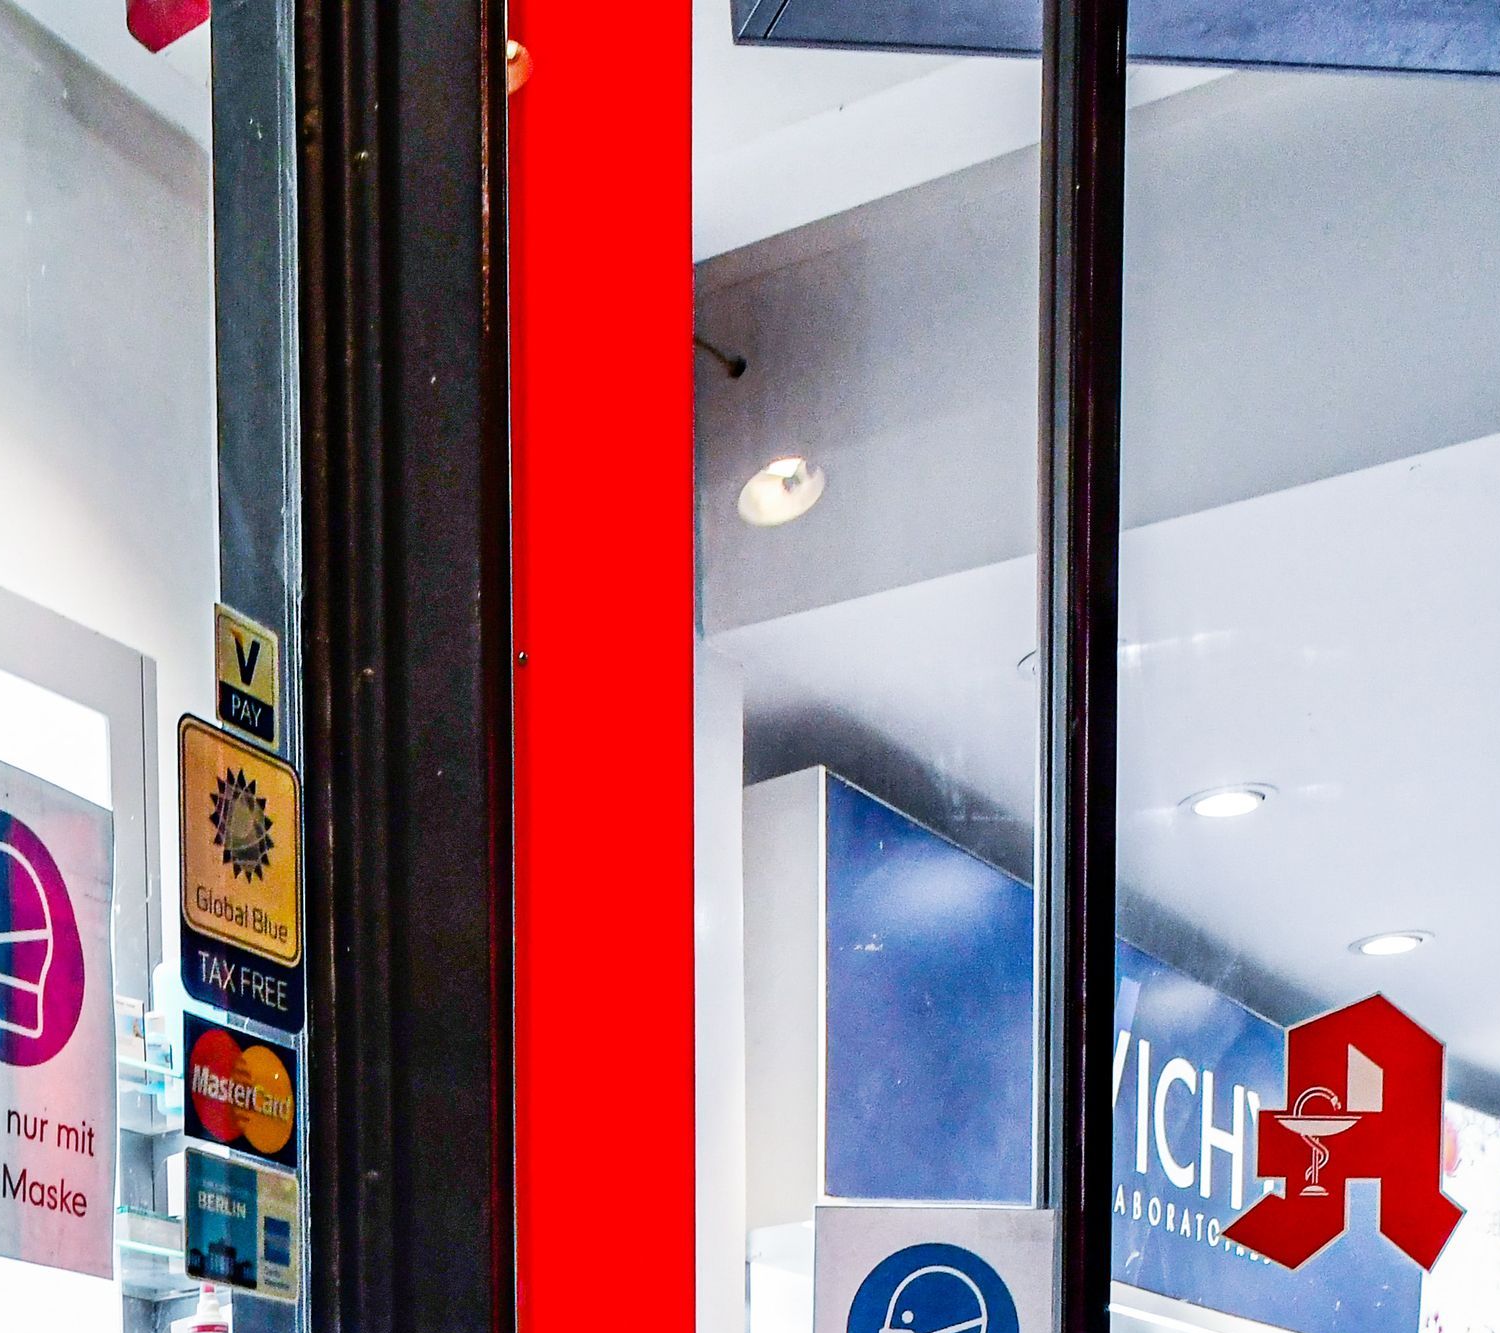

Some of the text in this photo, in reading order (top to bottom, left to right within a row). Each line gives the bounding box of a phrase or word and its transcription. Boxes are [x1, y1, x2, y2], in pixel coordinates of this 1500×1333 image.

[230, 692, 263, 727] PAY
[194, 885, 290, 946] Global Blue
[197, 949, 290, 1014] TAX FREE
[190, 1062, 293, 1123] MasterCard
[6, 1108, 49, 1143] nur
[56, 1120, 96, 1158] mit
[196, 1191, 248, 1219] BERLIN
